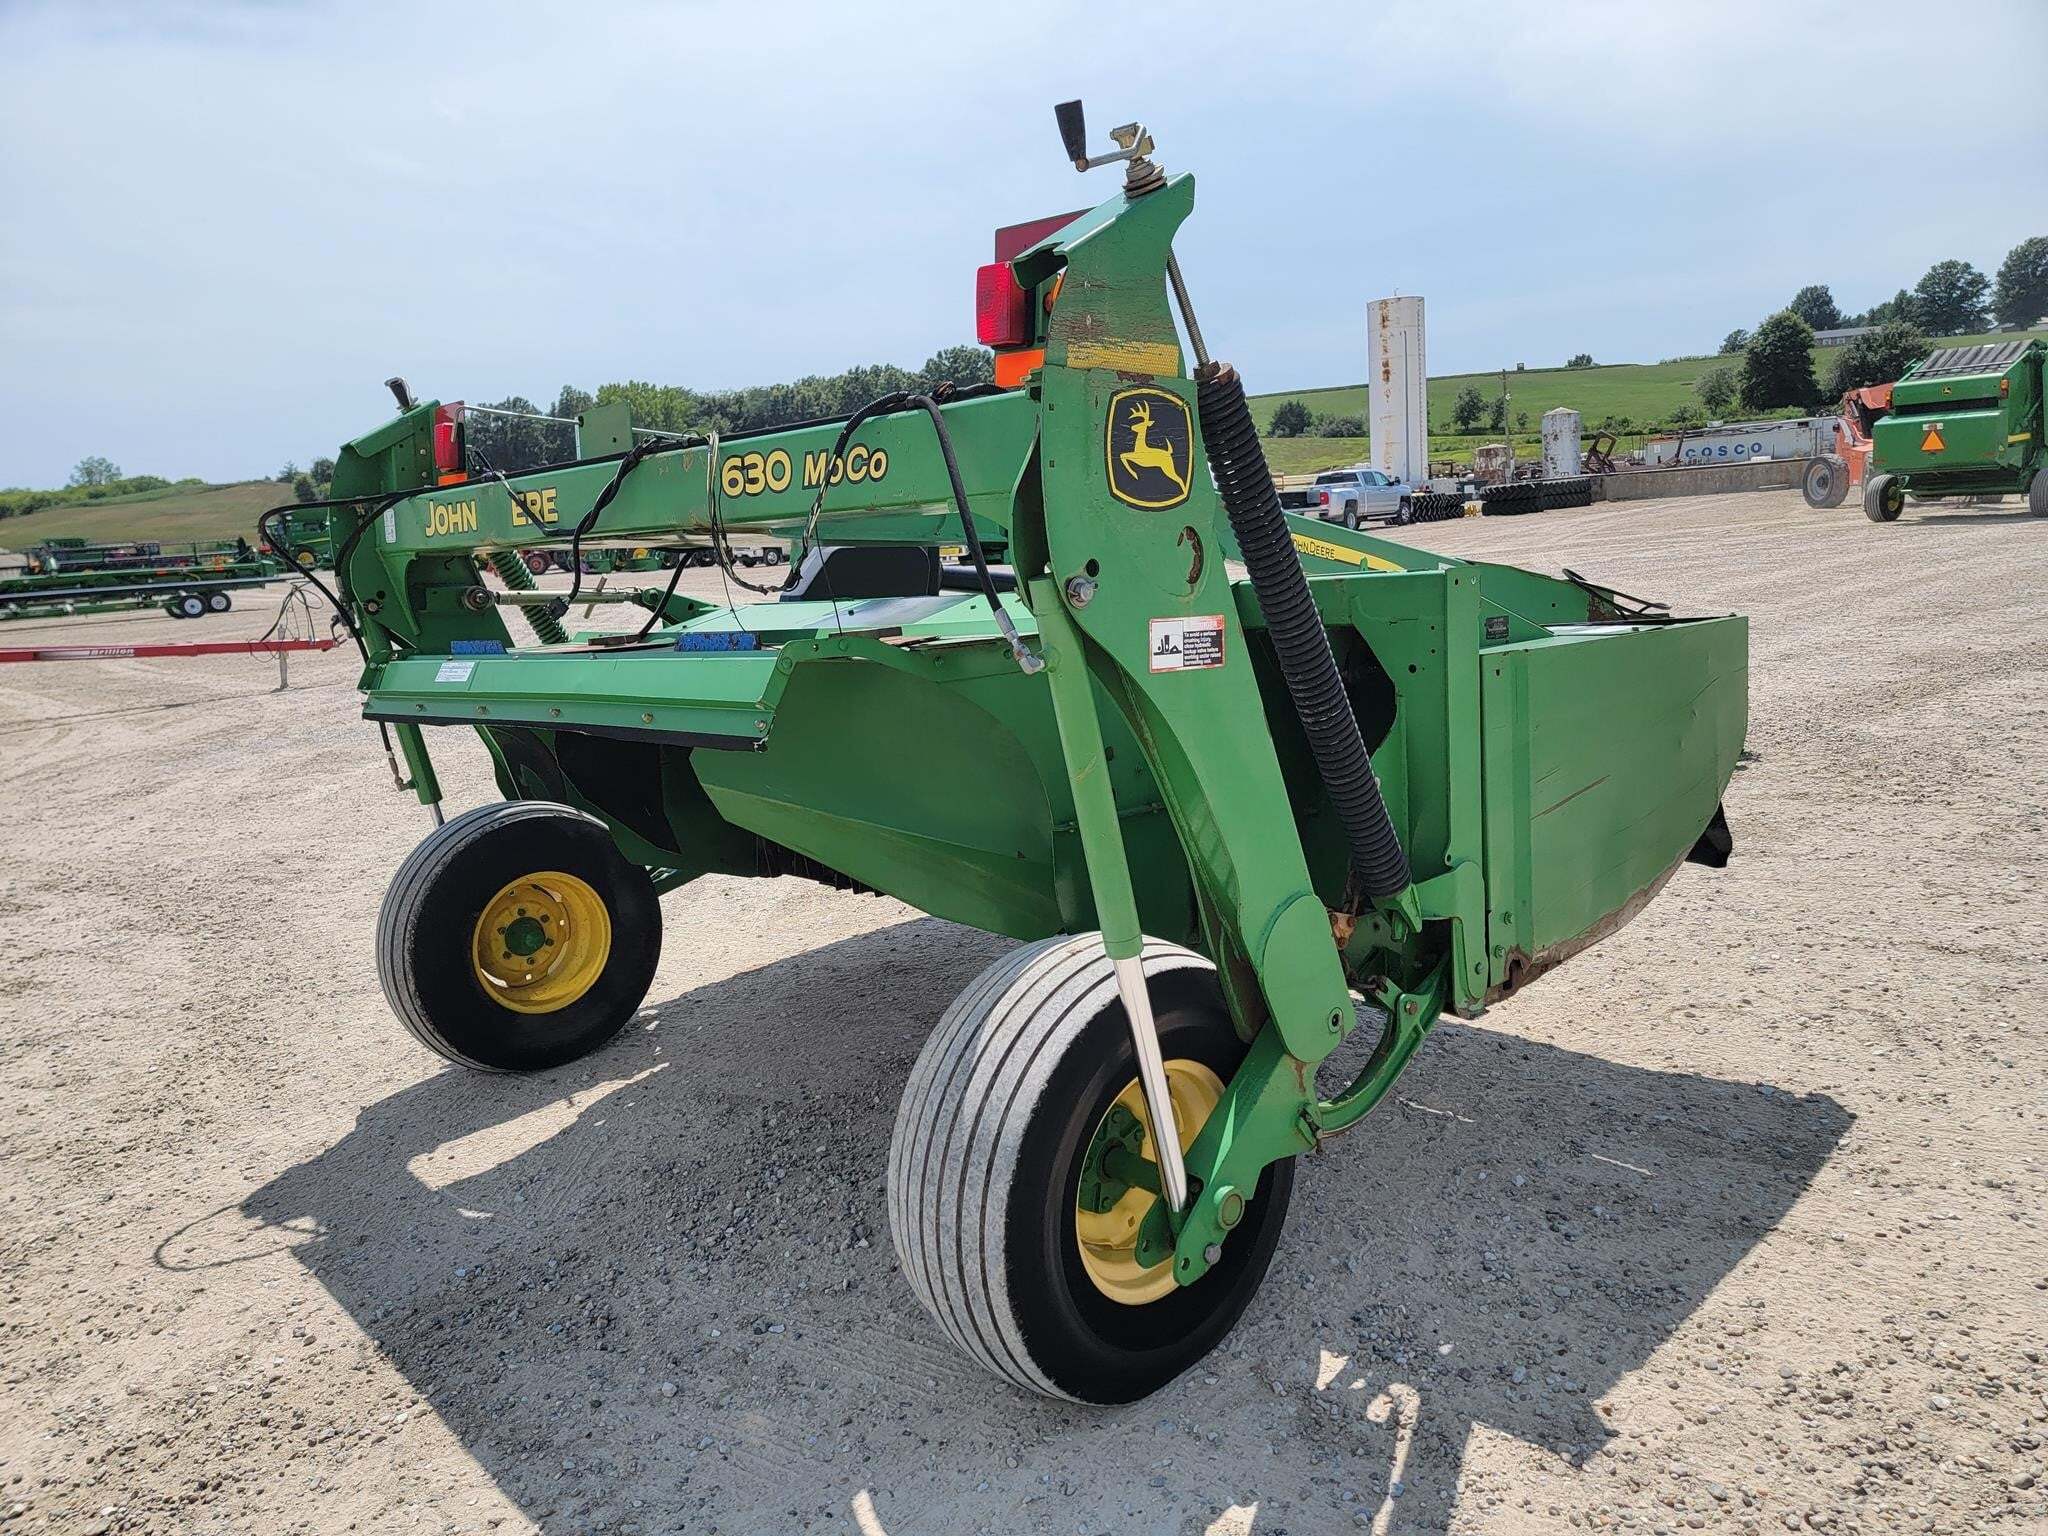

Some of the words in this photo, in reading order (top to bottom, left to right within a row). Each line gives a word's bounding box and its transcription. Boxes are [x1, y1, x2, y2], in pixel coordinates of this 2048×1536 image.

[1685, 442, 1762, 459] COSCO
[721, 448, 792, 498] 630
[803, 444, 888, 490] MoCo
[425, 500, 478, 537] JOHN
[1292, 538, 1309, 553] OHN
[1309, 540, 1335, 558] DEERE
